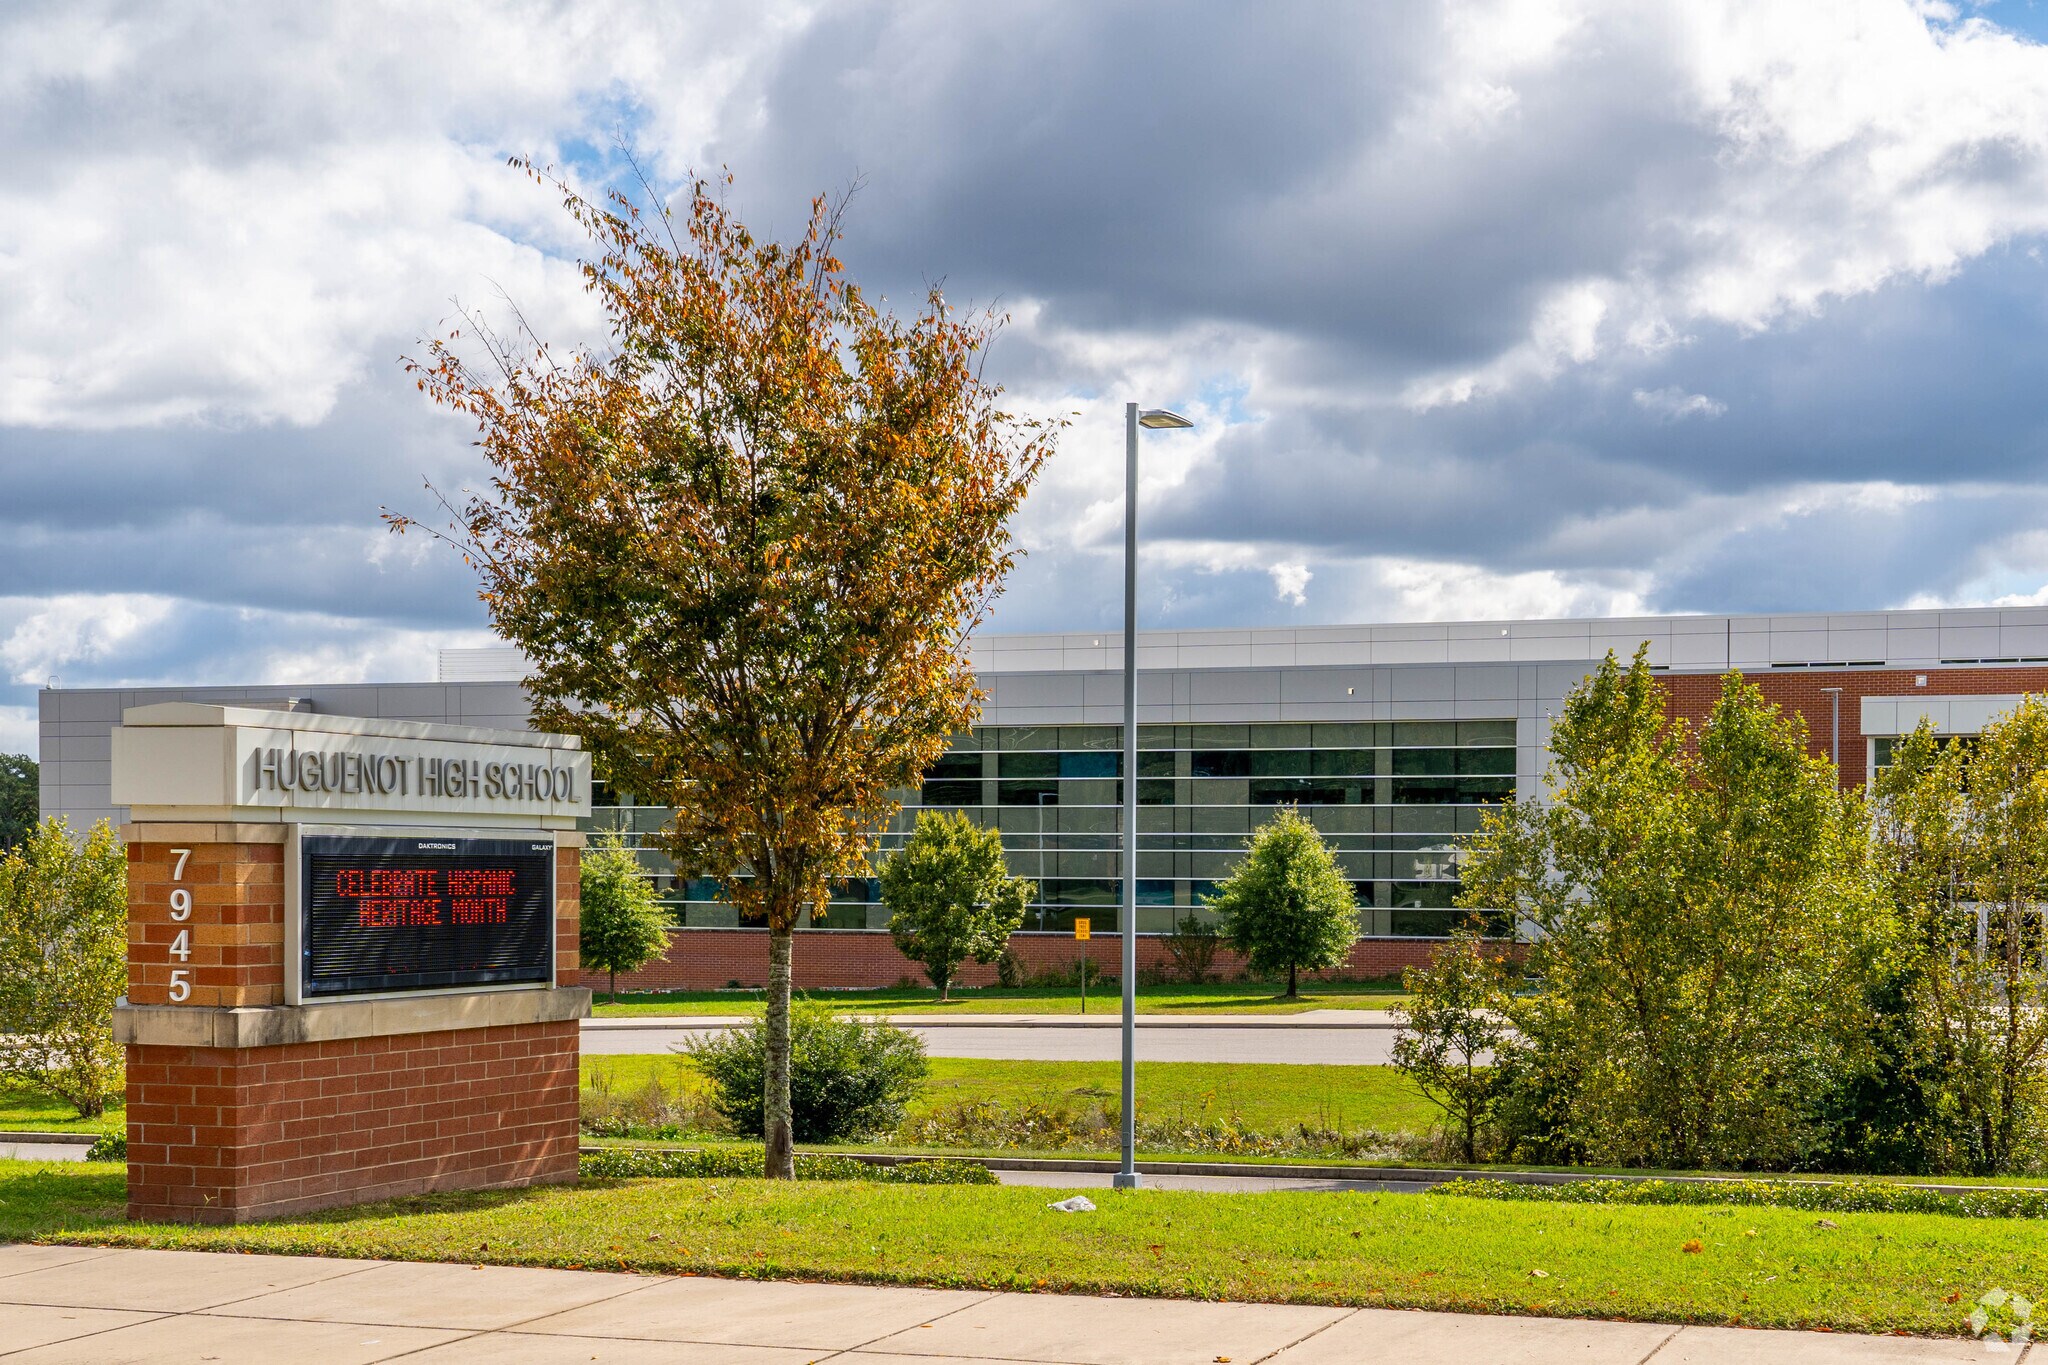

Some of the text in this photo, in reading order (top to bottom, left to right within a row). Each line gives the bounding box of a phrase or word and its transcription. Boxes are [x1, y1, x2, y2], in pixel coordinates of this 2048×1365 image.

[254, 747, 582, 803] HUGUENOT HIGH SCHOOL
[336, 869, 516, 897] CELEBRATE HISPANIC
[359, 898, 507, 926] HERITAGE MONTH
